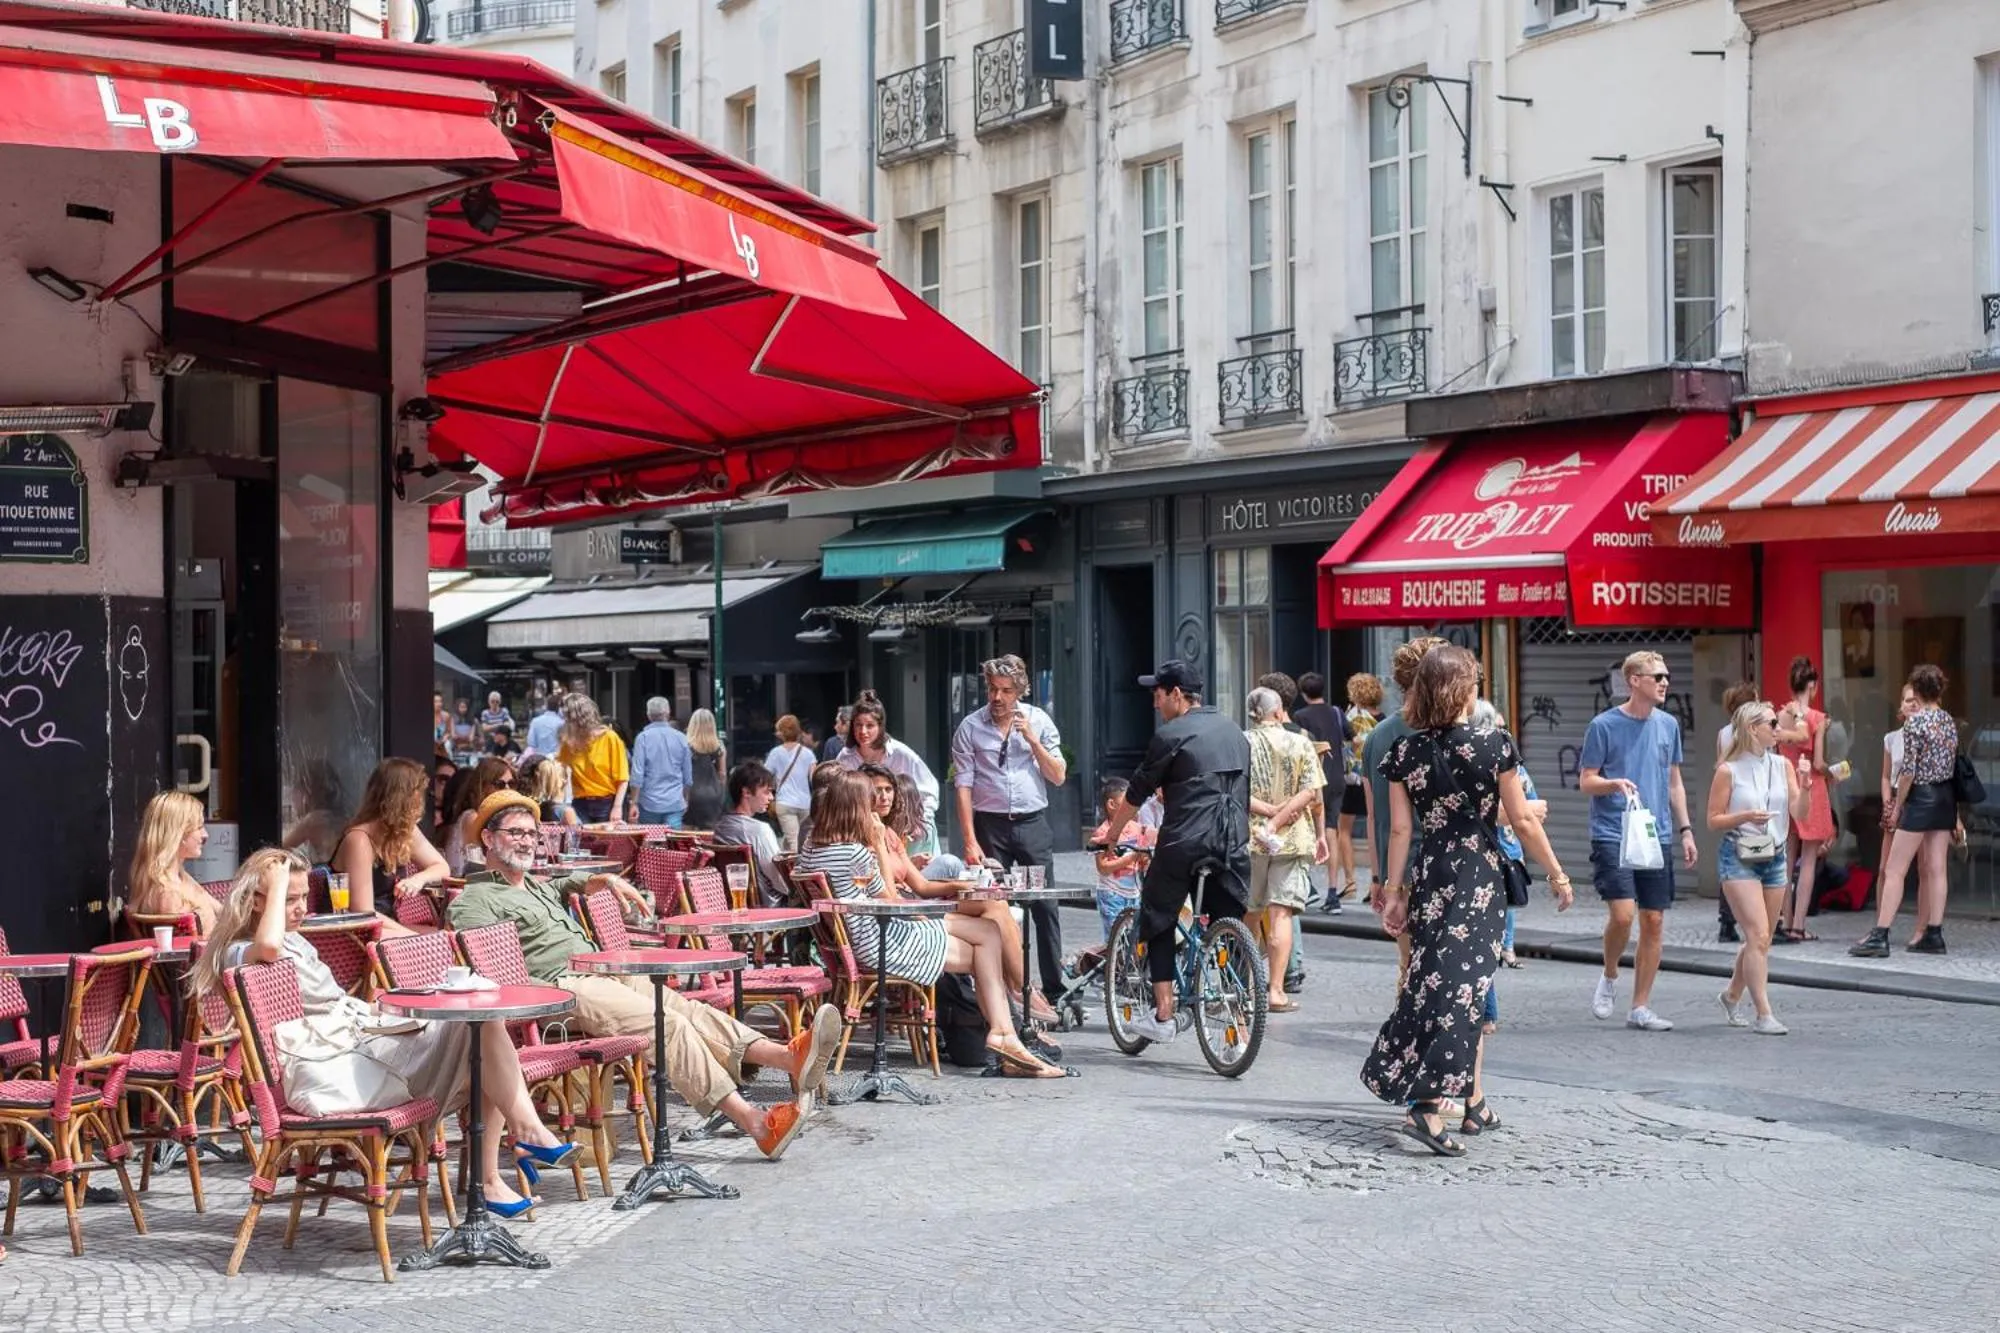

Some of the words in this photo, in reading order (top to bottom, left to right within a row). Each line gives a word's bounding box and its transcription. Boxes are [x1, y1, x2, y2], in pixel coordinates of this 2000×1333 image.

[96, 74, 199, 151] LB
[728, 212, 760, 279] LB
[24, 485, 49, 498] RUE
[1641, 474, 1692, 495] TRIP
[1223, 499, 1269, 530] HÔTEL
[1278, 494, 1353, 518] VICTOIRES
[1885, 502, 1942, 532] Anaïs
[1678, 515, 1726, 543] Anaïs
[623, 537, 668, 551] BIANCO
[488, 554, 503, 564] LE
[1402, 580, 1486, 607] BOUCHERIE
[1592, 582, 1732, 606] ROTISSERIE
